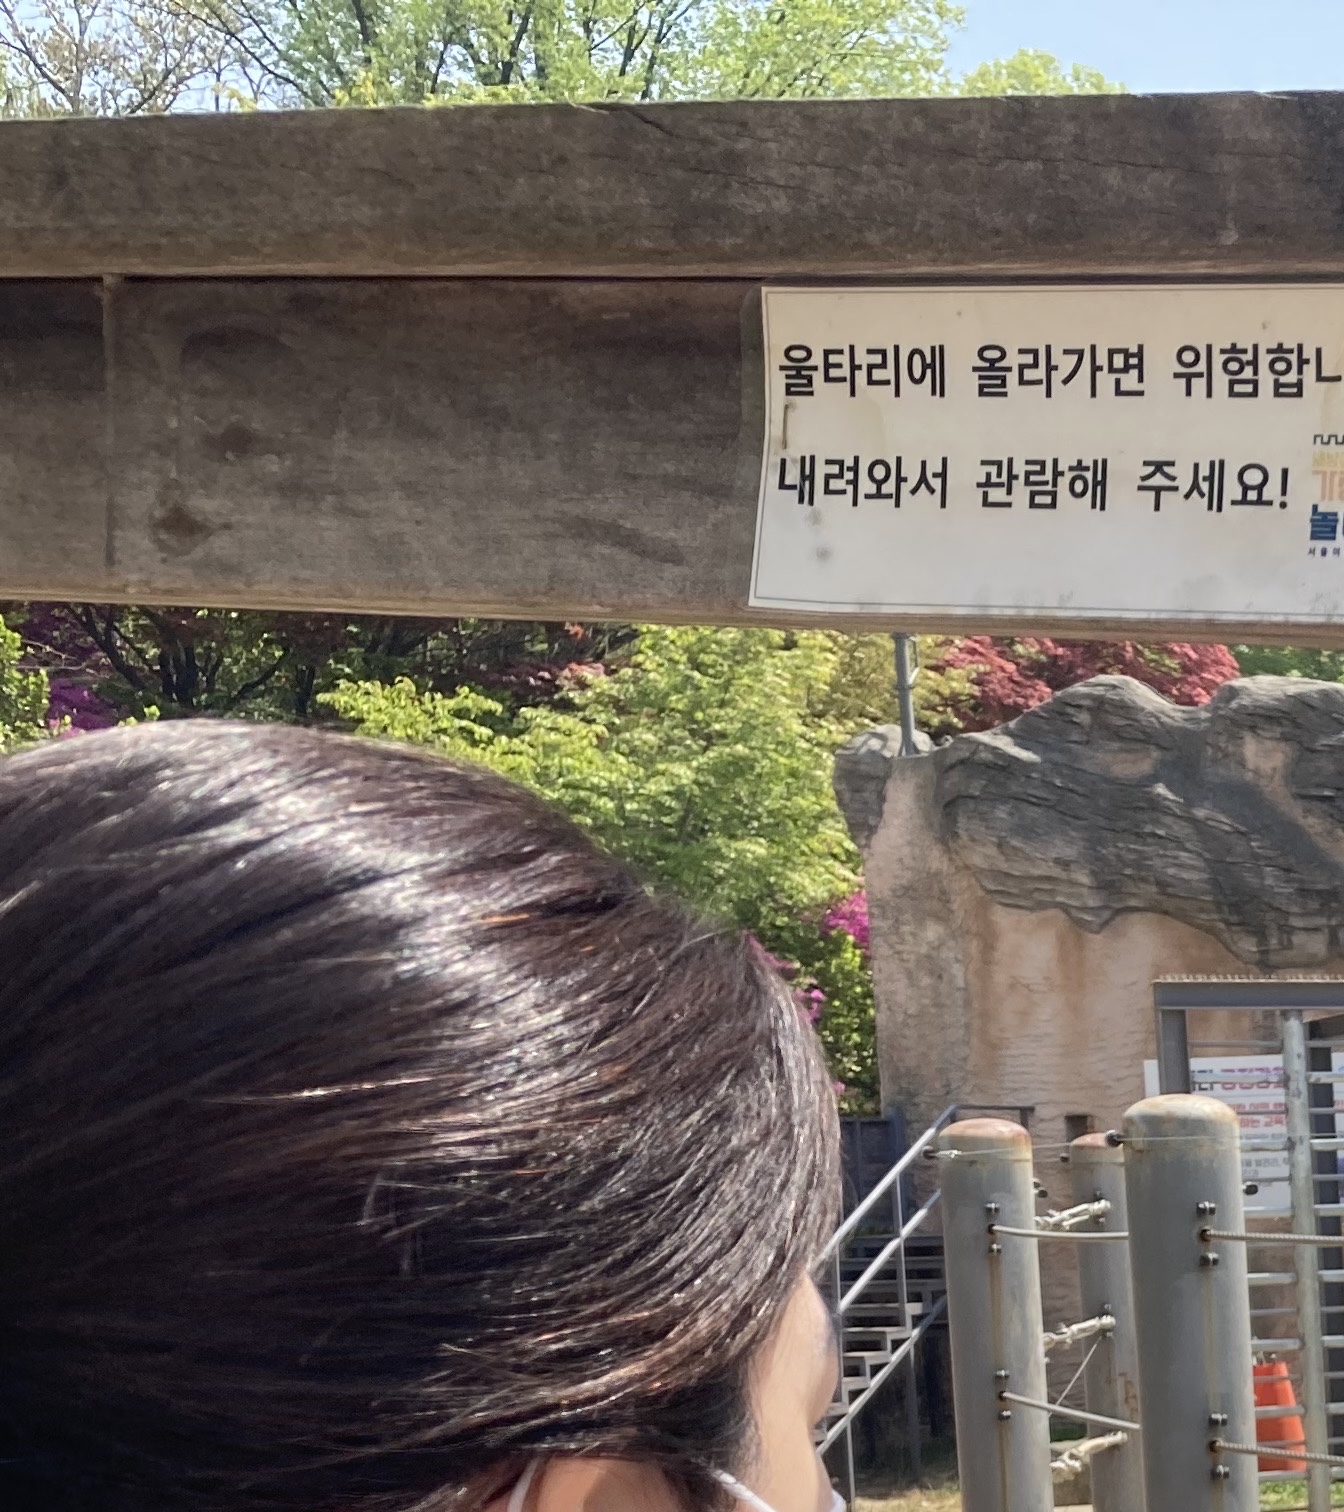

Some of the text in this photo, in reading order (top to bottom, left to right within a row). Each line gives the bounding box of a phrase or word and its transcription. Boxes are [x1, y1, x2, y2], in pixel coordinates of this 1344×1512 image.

[778, 344, 946, 398] 울타리에
[971, 343, 1145, 399] 올라가면
[777, 454, 1289, 513] 내려와서 관람해 주세요!
